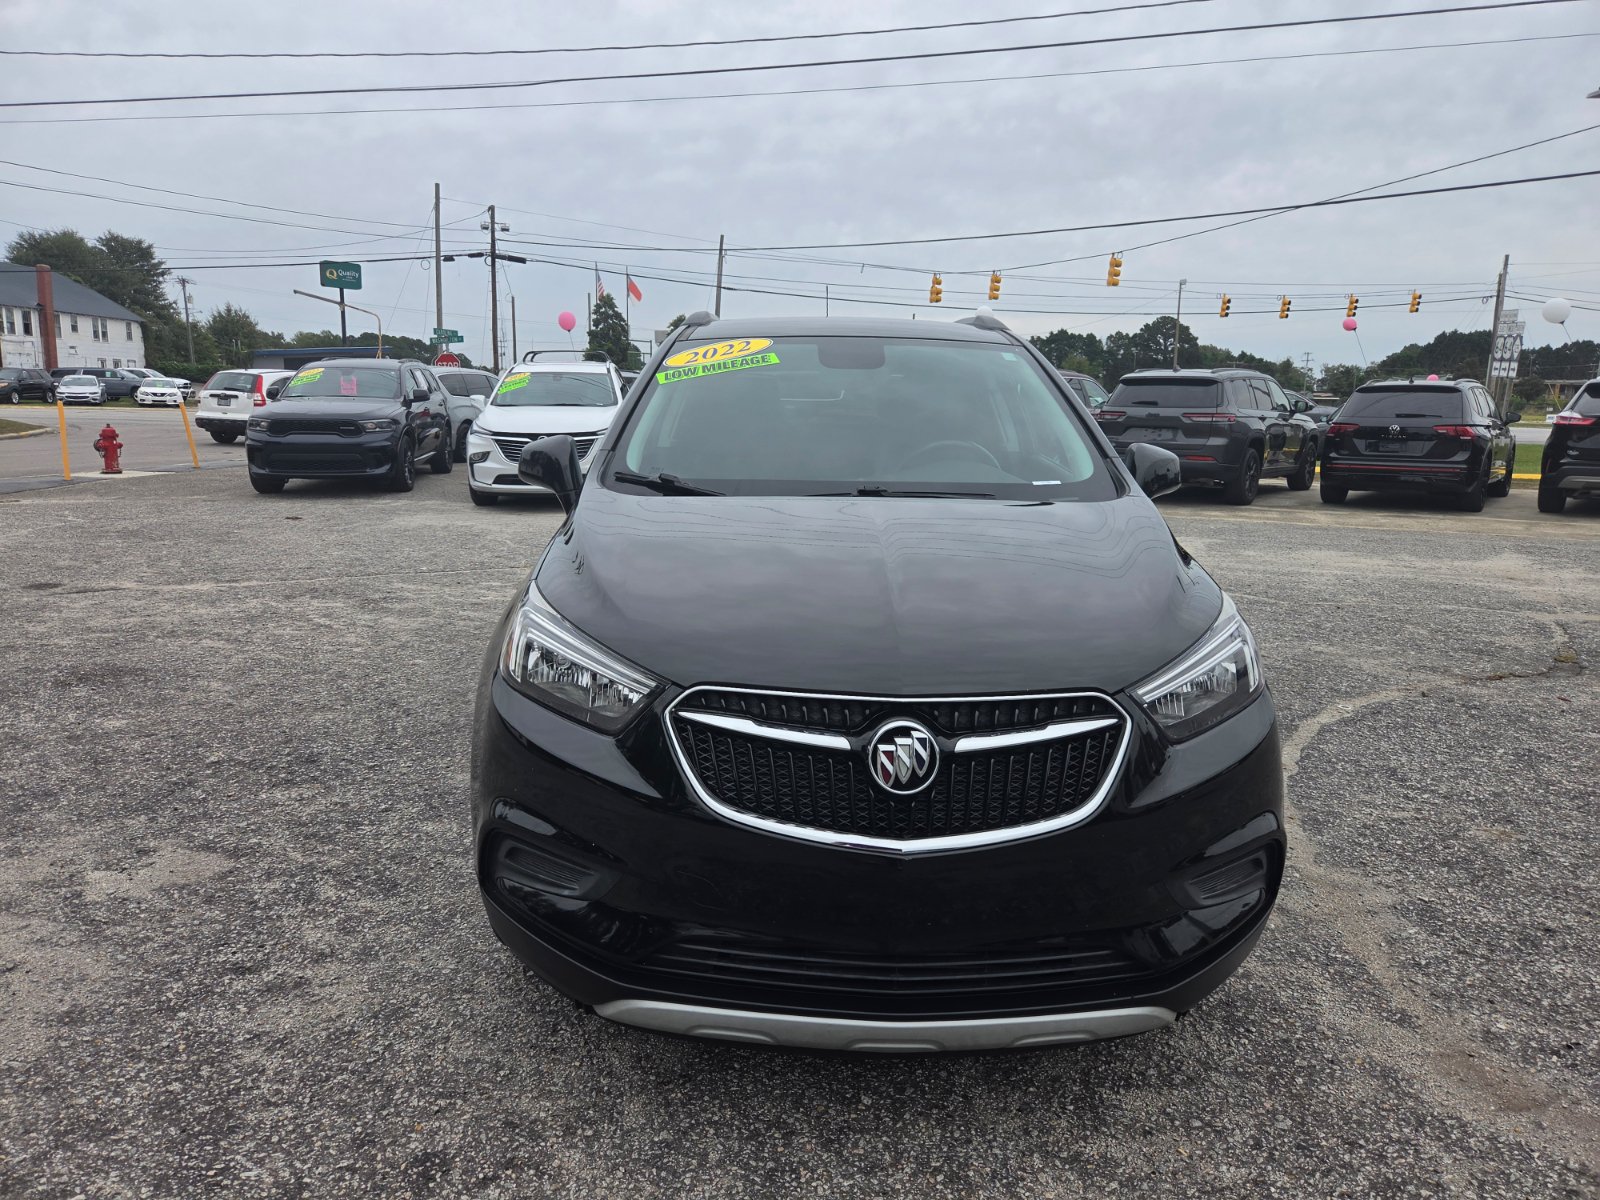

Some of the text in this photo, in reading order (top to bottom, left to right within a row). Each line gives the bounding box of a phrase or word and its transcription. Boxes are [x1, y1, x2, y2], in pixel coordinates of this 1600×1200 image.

[338, 269, 359, 279] Quality
[685, 341, 751, 364] 2022
[664, 354, 772, 381] LOW MILEAGE
